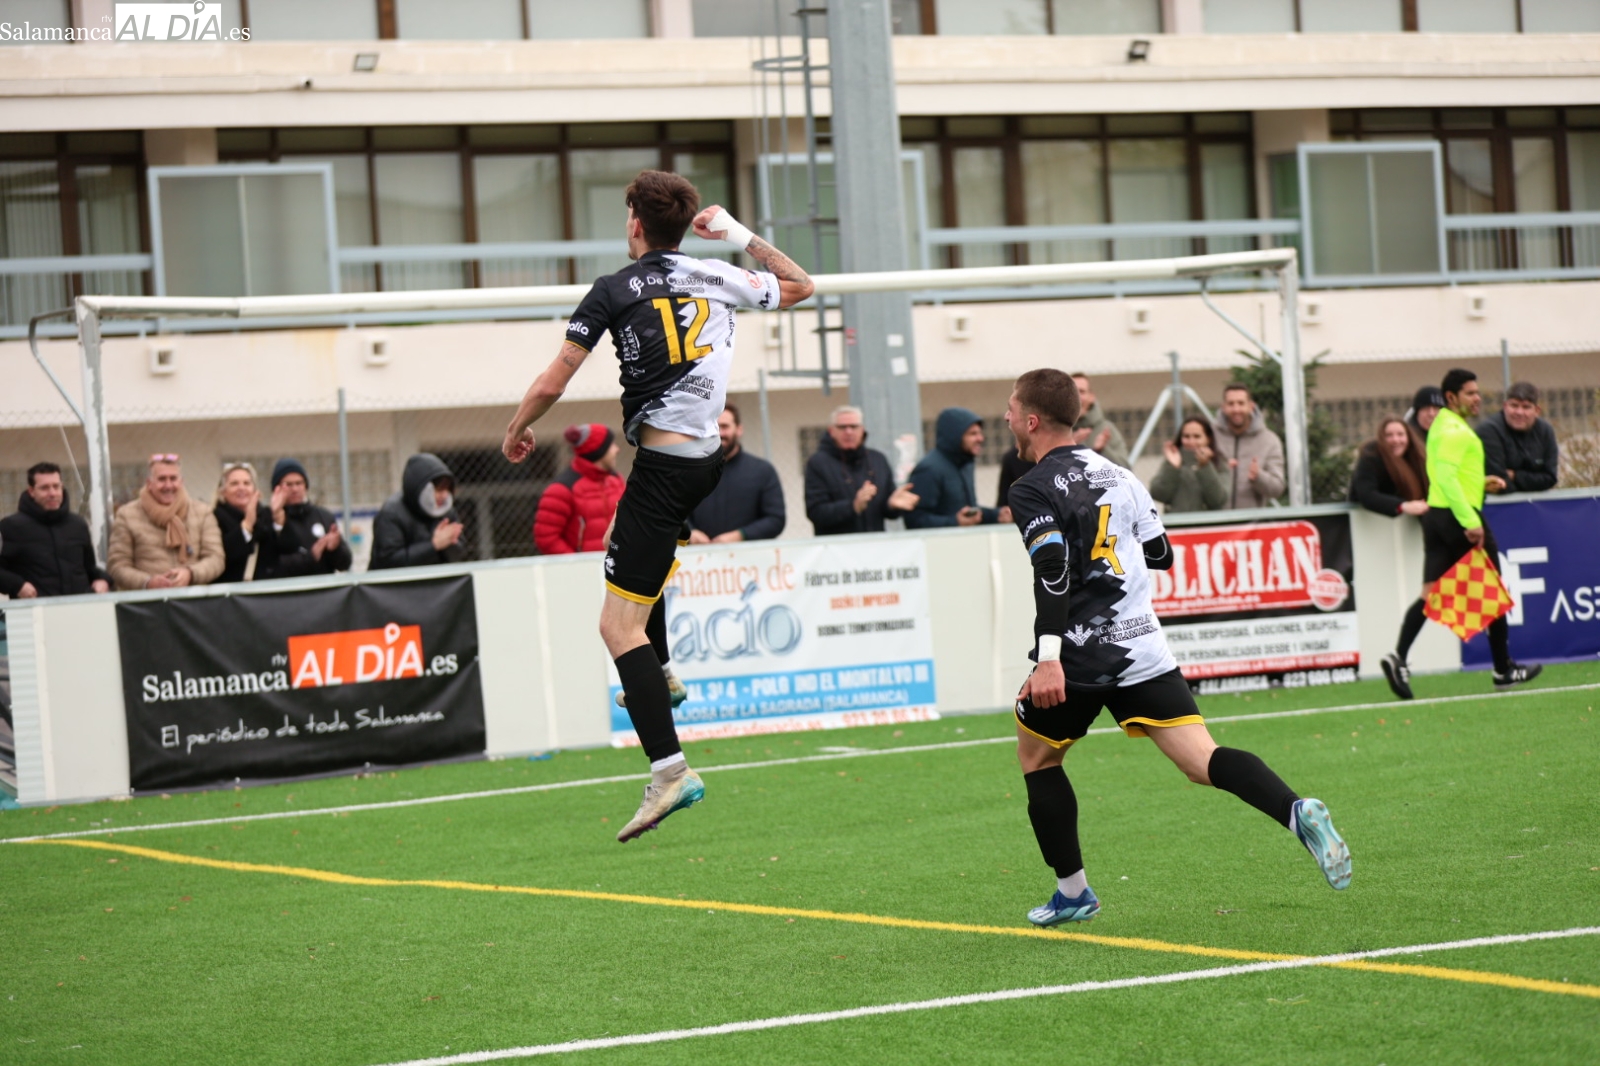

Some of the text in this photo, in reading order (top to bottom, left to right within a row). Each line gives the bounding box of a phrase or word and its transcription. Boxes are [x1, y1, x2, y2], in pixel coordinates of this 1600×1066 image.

[647, 276, 664, 286] De
[667, 275, 703, 286] Castro
[651, 297, 714, 365] 12
[1068, 472, 1083, 482] De
[1083, 468, 1115, 482] Castro
[1090, 504, 1125, 576] 4
[672, 547, 795, 597] mántica de
[665, 580, 802, 662] acío
[142, 669, 290, 703] Salamanca
[820, 672, 836, 691] EL
[161, 705, 445, 755] El periódico de toda Salamanca
